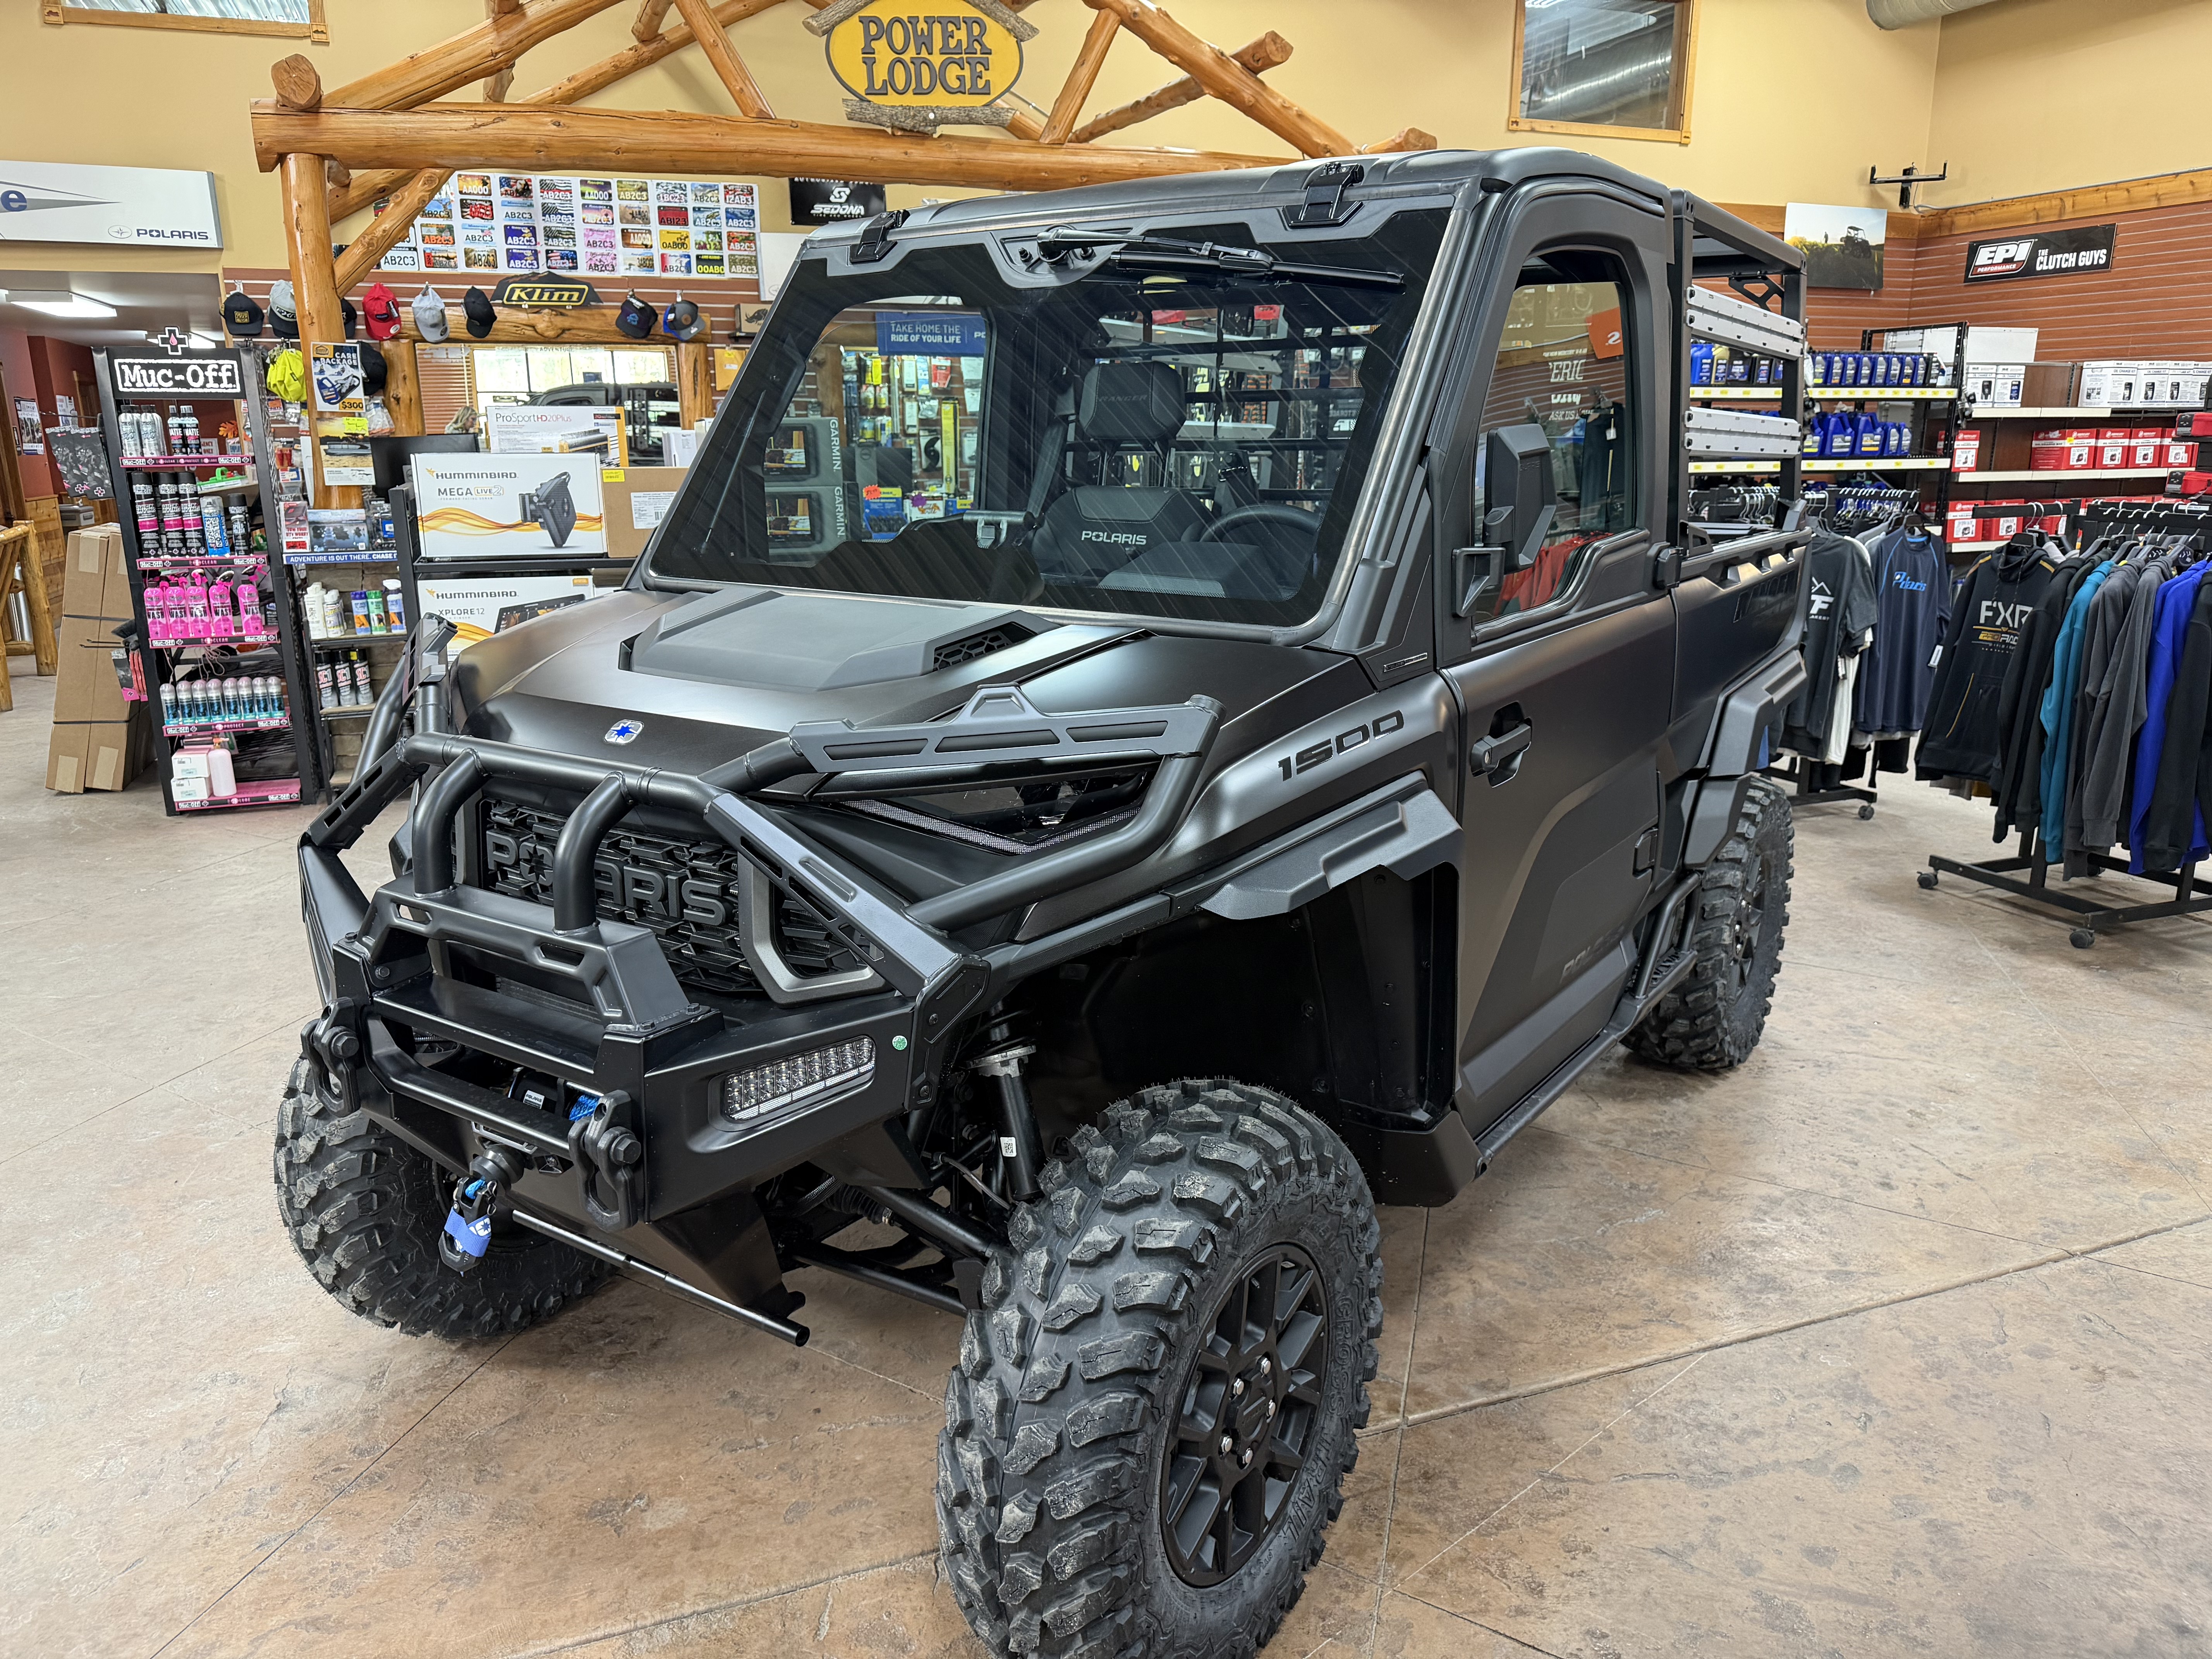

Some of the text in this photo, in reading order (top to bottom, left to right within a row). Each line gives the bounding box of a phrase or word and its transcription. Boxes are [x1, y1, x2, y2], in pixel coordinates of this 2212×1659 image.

[859, 15, 992, 55] POWER
[862, 57, 990, 95] LODGE
[619, 191, 647, 200] AB2C3
[810, 204, 865, 215] SEDONA
[728, 218, 754, 227] AB2C3
[136, 228, 209, 240] POLARIS
[424, 236, 454, 244] AB2C3
[507, 237, 536, 245] AB2C3
[586, 240, 614, 248] AB2C3
[730, 242, 756, 251] AB2C3
[1975, 242, 2032, 266] EPI
[383, 256, 416, 266] AB2C3
[509, 260, 538, 268] AB2C3
[2036, 249, 2107, 271] CLUTCH GUYS
[731, 265, 757, 273] AB2C3
[1977, 264, 2016, 273] PERFORMANCE
[891, 323, 961, 334] TAKE HOME THE
[891, 334, 909, 342] RIDE
[910, 334, 921, 342] OF
[944, 335, 961, 343] LIFE
[320, 357, 358, 366] PACKAGE
[121, 364, 236, 388] Muc-Off
[341, 401, 364, 409] $300
[829, 419, 842, 470] GARMIN
[438, 487, 473, 496] MEGA
[834, 486, 845, 536] GARMIN
[1081, 530, 1147, 545] POLARIS
[436, 591, 517, 599] HUMMINBIRD
[1278, 709, 1405, 782] 1500
[486, 829, 734, 927] POARIS
[525, 1093, 543, 1103] POLARIS
[1326, 1296, 1353, 1417] CROSS
